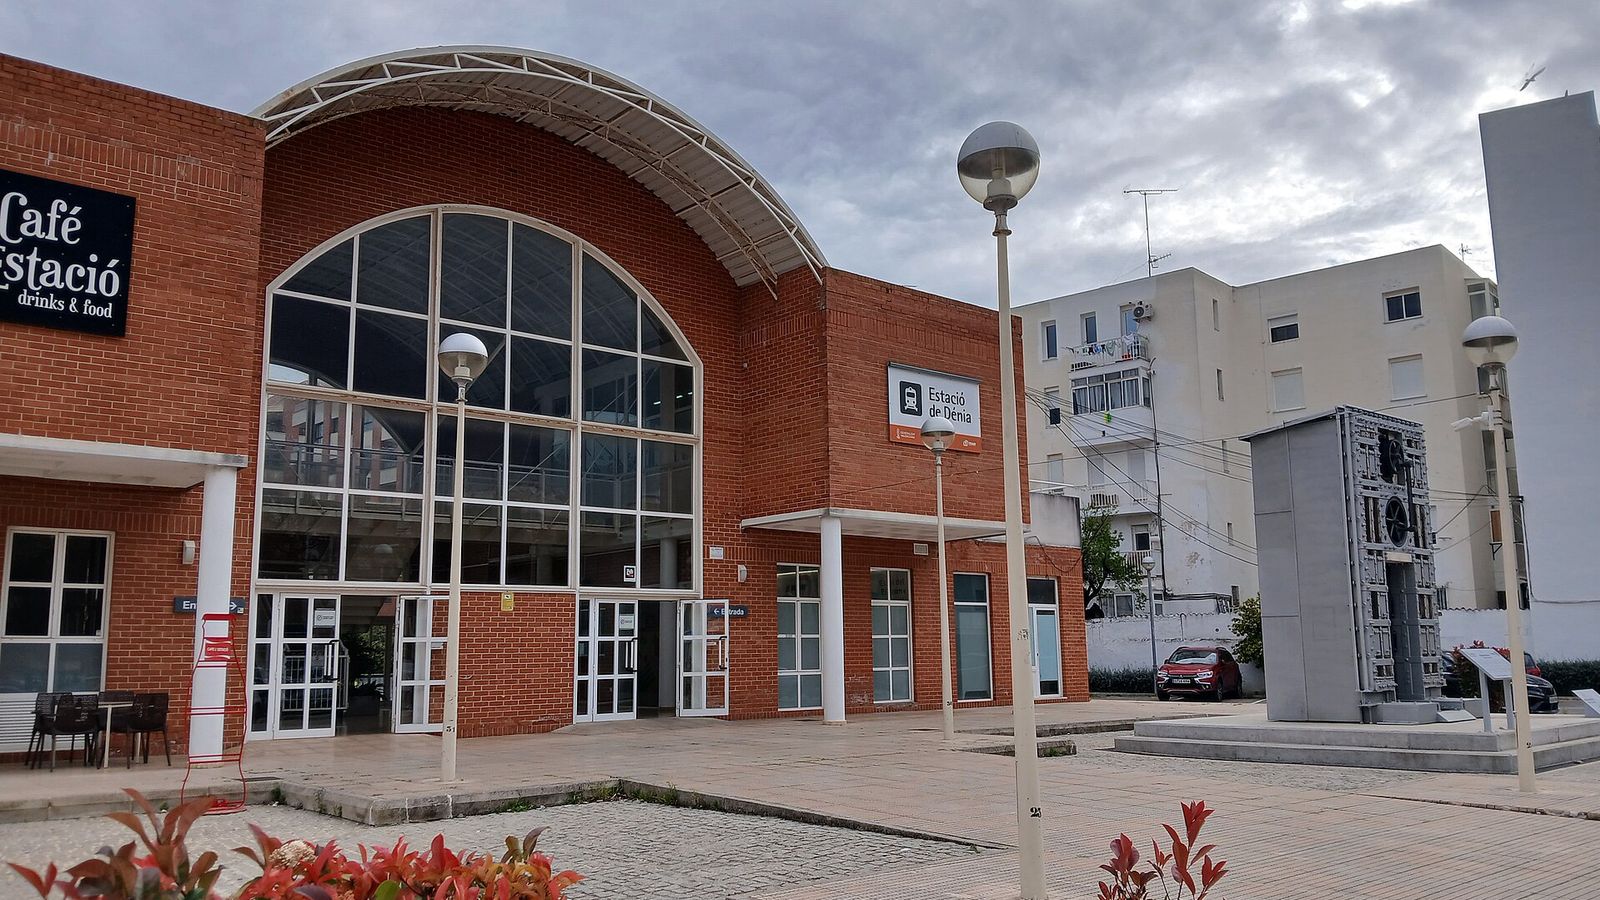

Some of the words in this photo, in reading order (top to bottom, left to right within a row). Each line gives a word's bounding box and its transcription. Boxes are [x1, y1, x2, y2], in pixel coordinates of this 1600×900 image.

[0, 192, 82, 245] Café
[18, 289, 65, 311] drinks
[69, 297, 79, 313] &
[83, 299, 113, 319] food
[928, 386, 966, 406] Estació
[929, 404, 941, 418] de
[944, 405, 972, 424] Dénia
